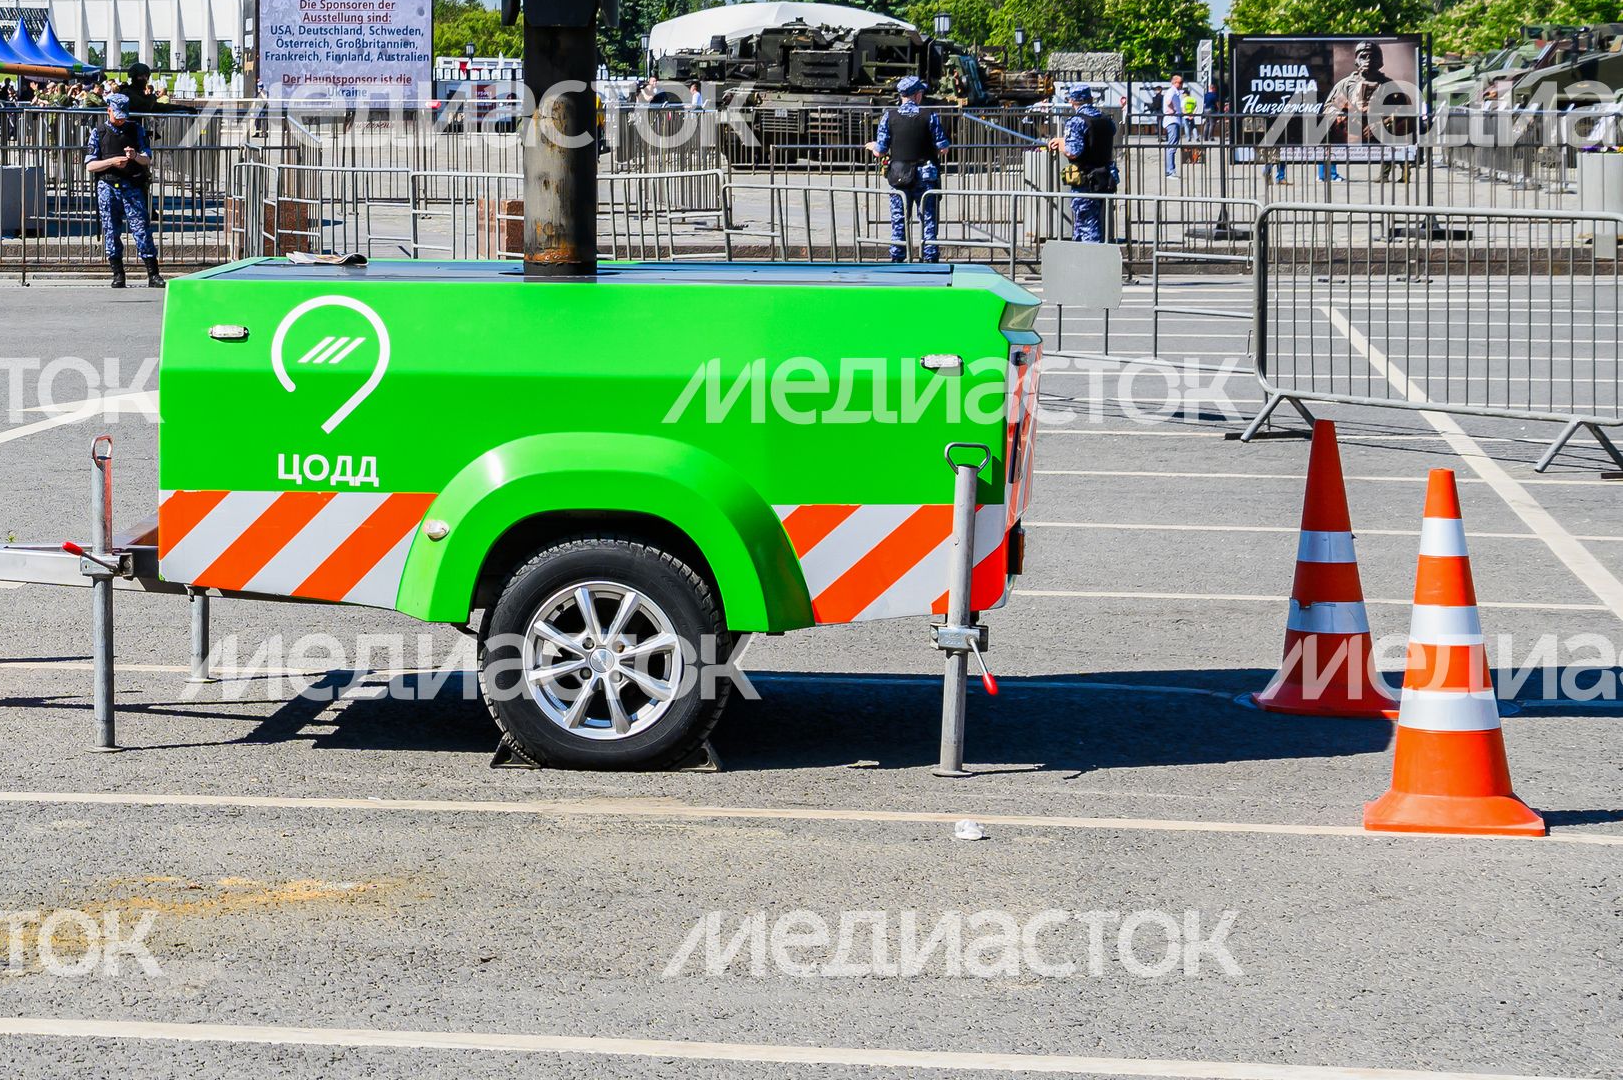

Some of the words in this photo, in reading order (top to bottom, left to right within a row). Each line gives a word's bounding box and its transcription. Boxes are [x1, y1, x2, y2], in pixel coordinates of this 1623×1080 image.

[299, 0, 317, 10] Die
[320, 0, 375, 11] Sponsoren
[378, 0, 395, 10] der
[302, 12, 364, 24] Ausstellung
[366, 12, 392, 23] sind:
[270, 25, 295, 37] USA,
[298, 25, 366, 37] Deutschland,
[369, 25, 424, 37] Schweden,
[276, 37, 332, 50] Österreich,
[335, 38, 418, 50] Großbritannien,
[265, 51, 322, 63] Frankreich,
[325, 51, 373, 63] Finnland,
[376, 51, 429, 62] Australien
[1259, 64, 1310, 78] НАША
[282, 74, 302, 85] Der
[304, 74, 377, 86] Hauptsponsor
[380, 74, 393, 85] ist
[395, 74, 413, 85] die
[327, 87, 368, 98] Ukraine
[1251, 79, 1318, 94] ПОБЕДА
[276, 453, 380, 488] ЦОДД
